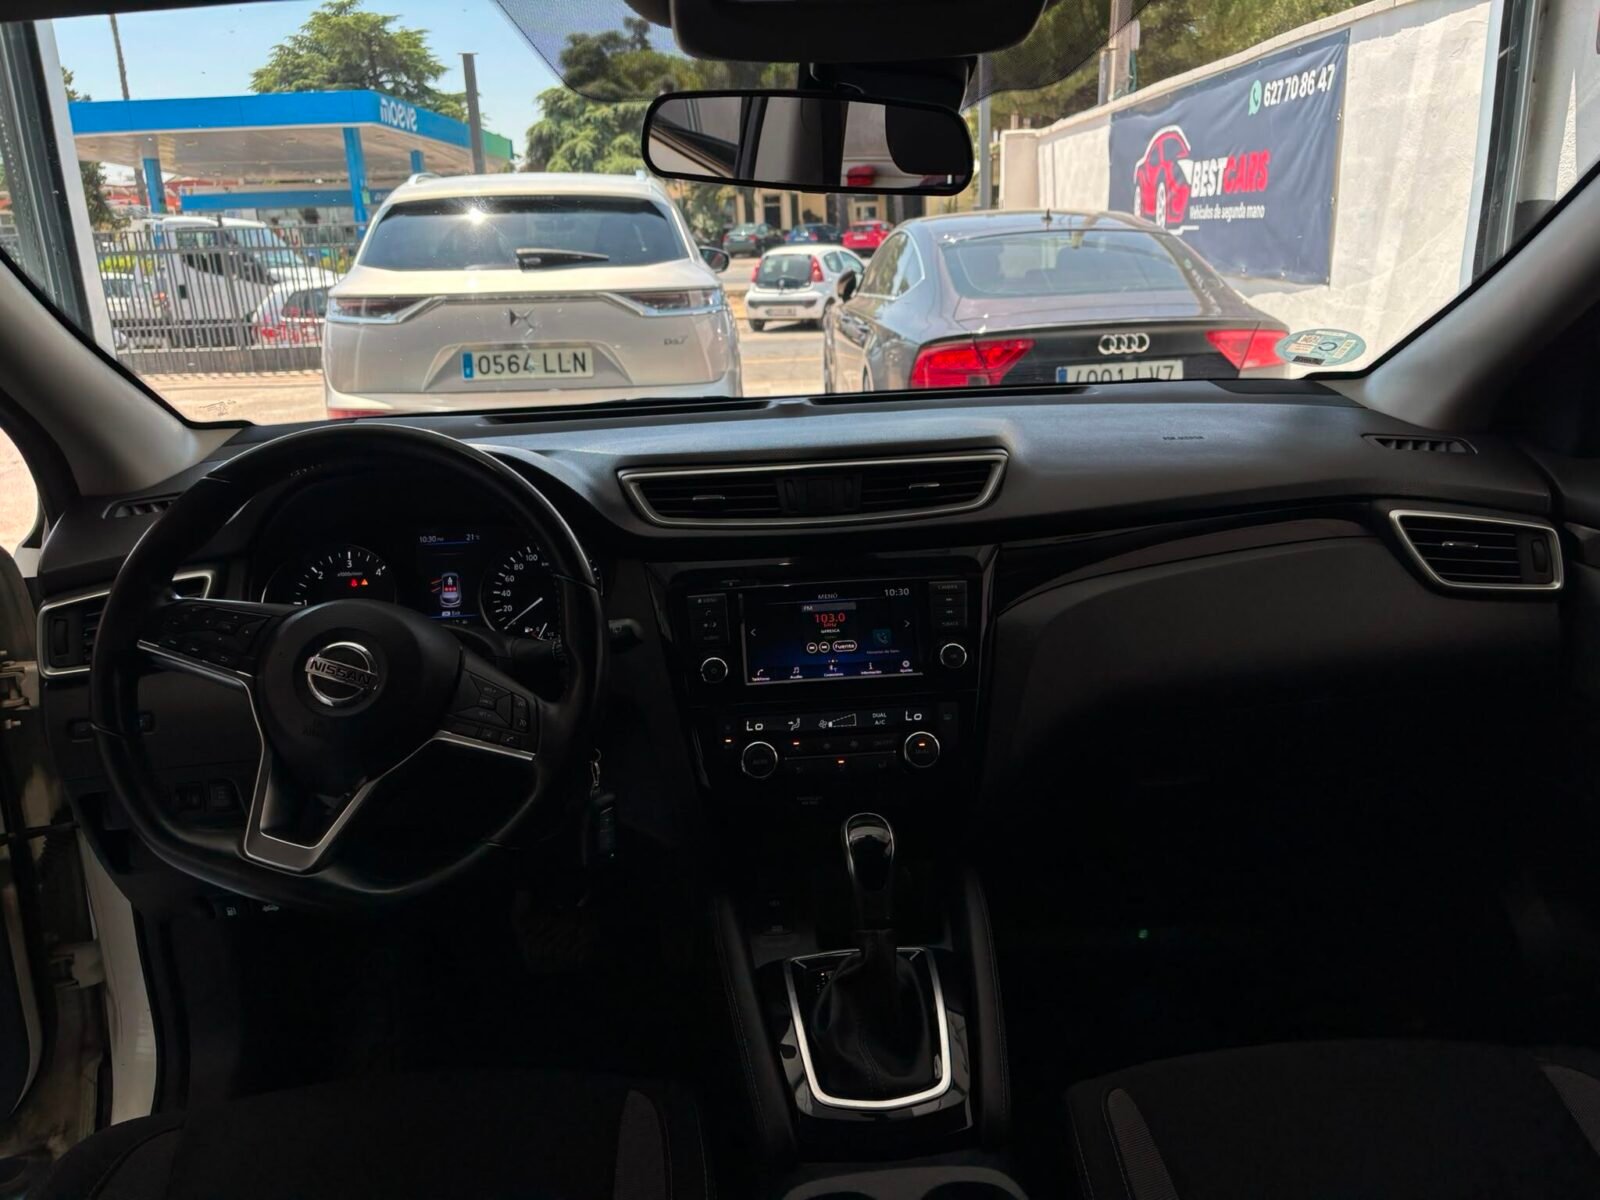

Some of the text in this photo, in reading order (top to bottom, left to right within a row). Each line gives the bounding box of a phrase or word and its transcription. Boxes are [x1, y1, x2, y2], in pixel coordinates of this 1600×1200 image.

[1263, 64, 1336, 107] 627 70 86 47
[1221, 201, 1247, 223] segunda
[1246, 204, 1266, 219] mano
[477, 352, 588, 376] 0564 LLN
[420, 535, 437, 543] 10:30
[346, 559, 353, 568] 3
[317, 571, 324, 580] 2
[375, 568, 382, 576] 4
[504, 575, 515, 583] 60
[883, 587, 910, 597] 10:30
[503, 604, 513, 612] 20
[815, 612, 846, 623] 103.0
[310, 660, 372, 685] NISSAN
[905, 710, 923, 721] Lo
[746, 721, 764, 731] Lo
